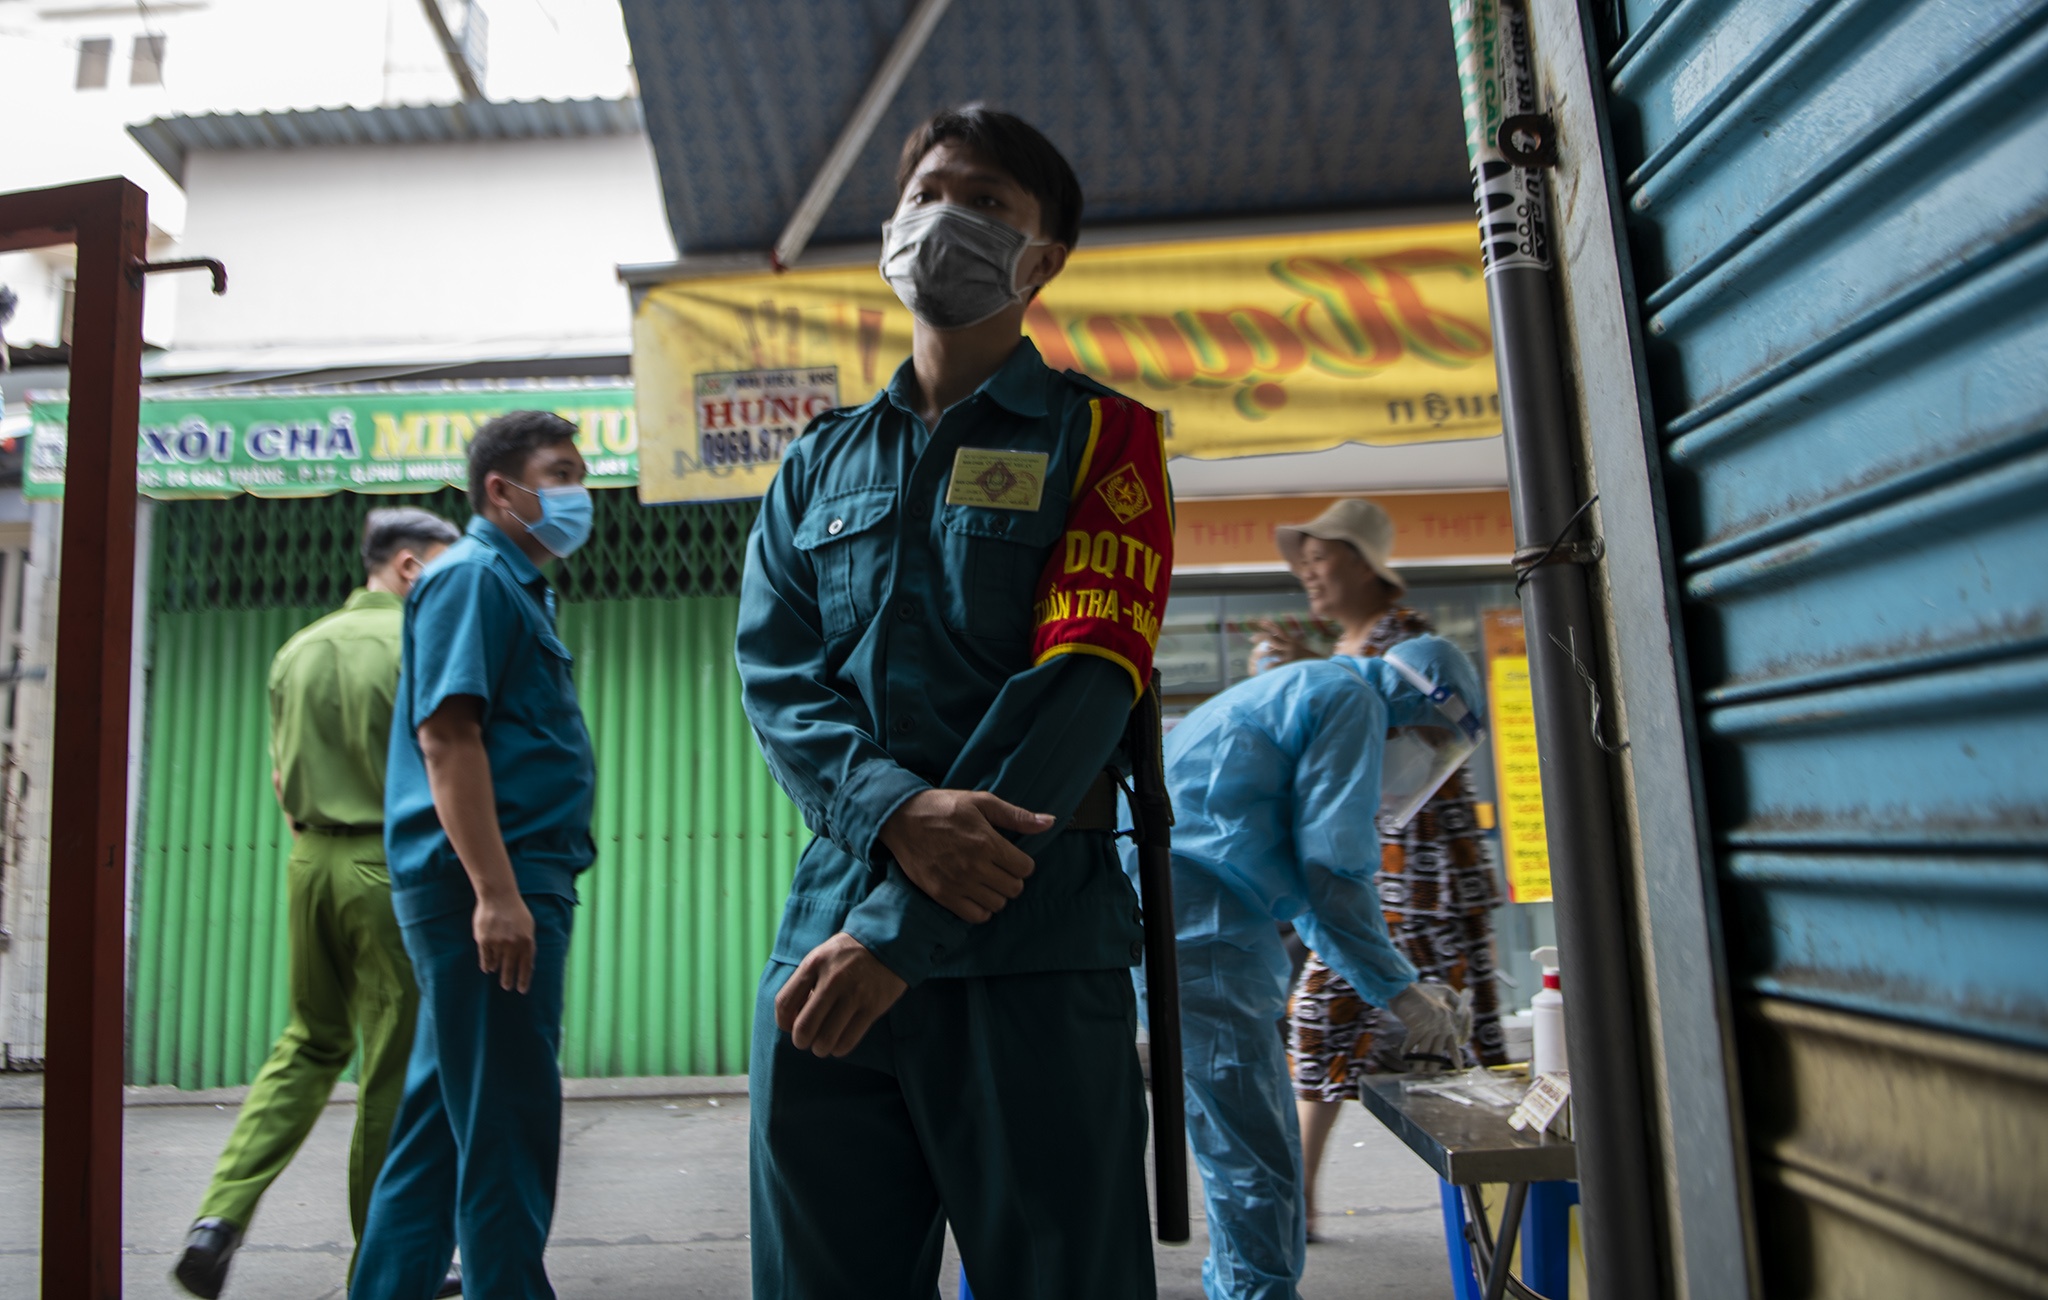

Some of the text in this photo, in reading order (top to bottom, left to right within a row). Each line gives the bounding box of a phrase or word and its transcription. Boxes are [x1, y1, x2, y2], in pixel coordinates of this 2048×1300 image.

[139, 413, 233, 464] XÔI
[371, 409, 491, 460] MIN
[1063, 530, 1161, 593] DQTV
[1033, 582, 1072, 631] TUẦN
